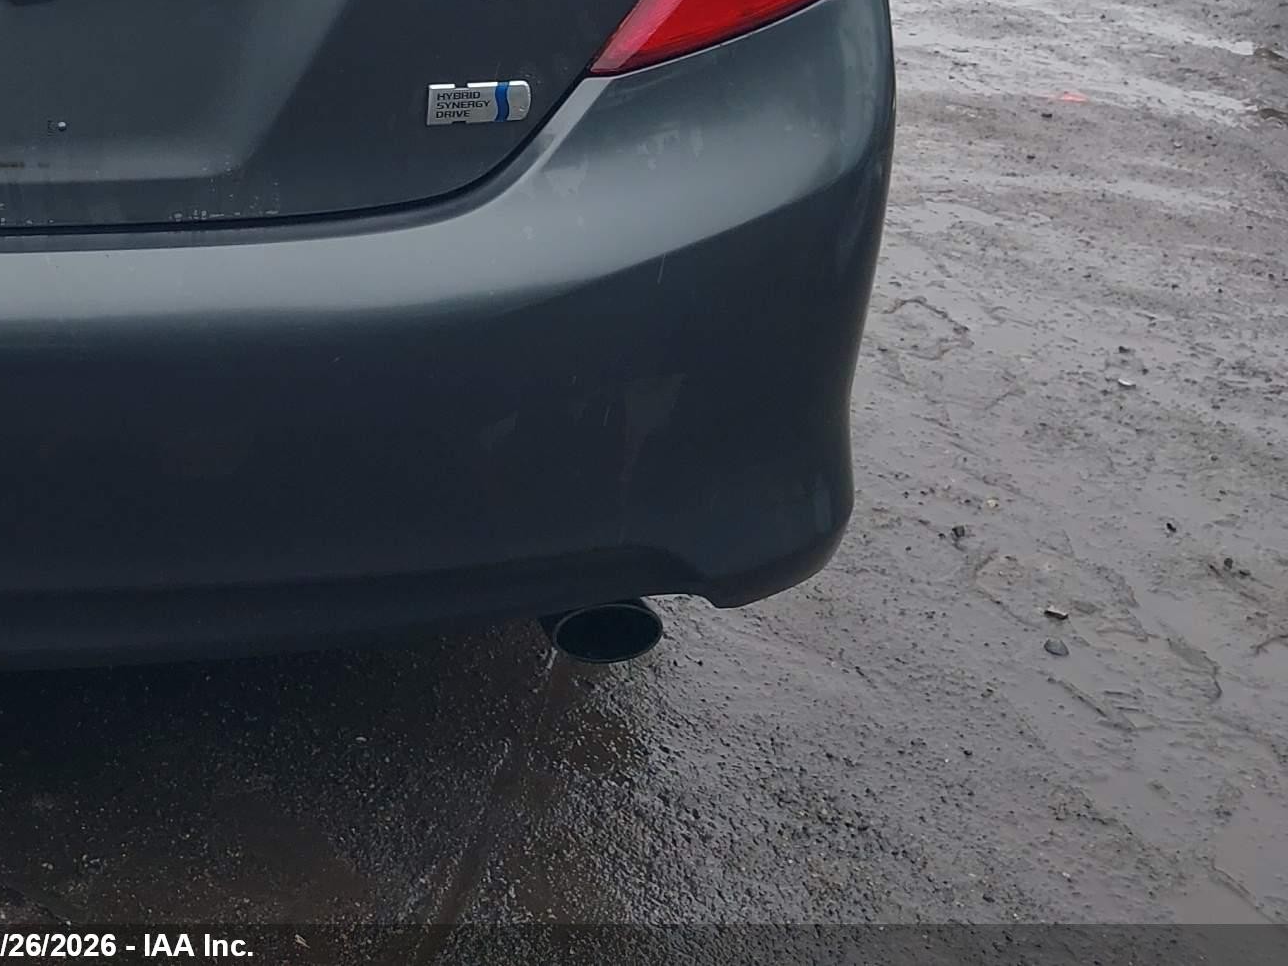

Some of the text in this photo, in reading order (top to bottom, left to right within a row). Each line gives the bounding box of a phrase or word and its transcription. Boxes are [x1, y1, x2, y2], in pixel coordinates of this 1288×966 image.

[437, 91, 481, 101] HYBRID
[436, 100, 491, 110] SYNERGY
[435, 109, 471, 119] DRIVE
